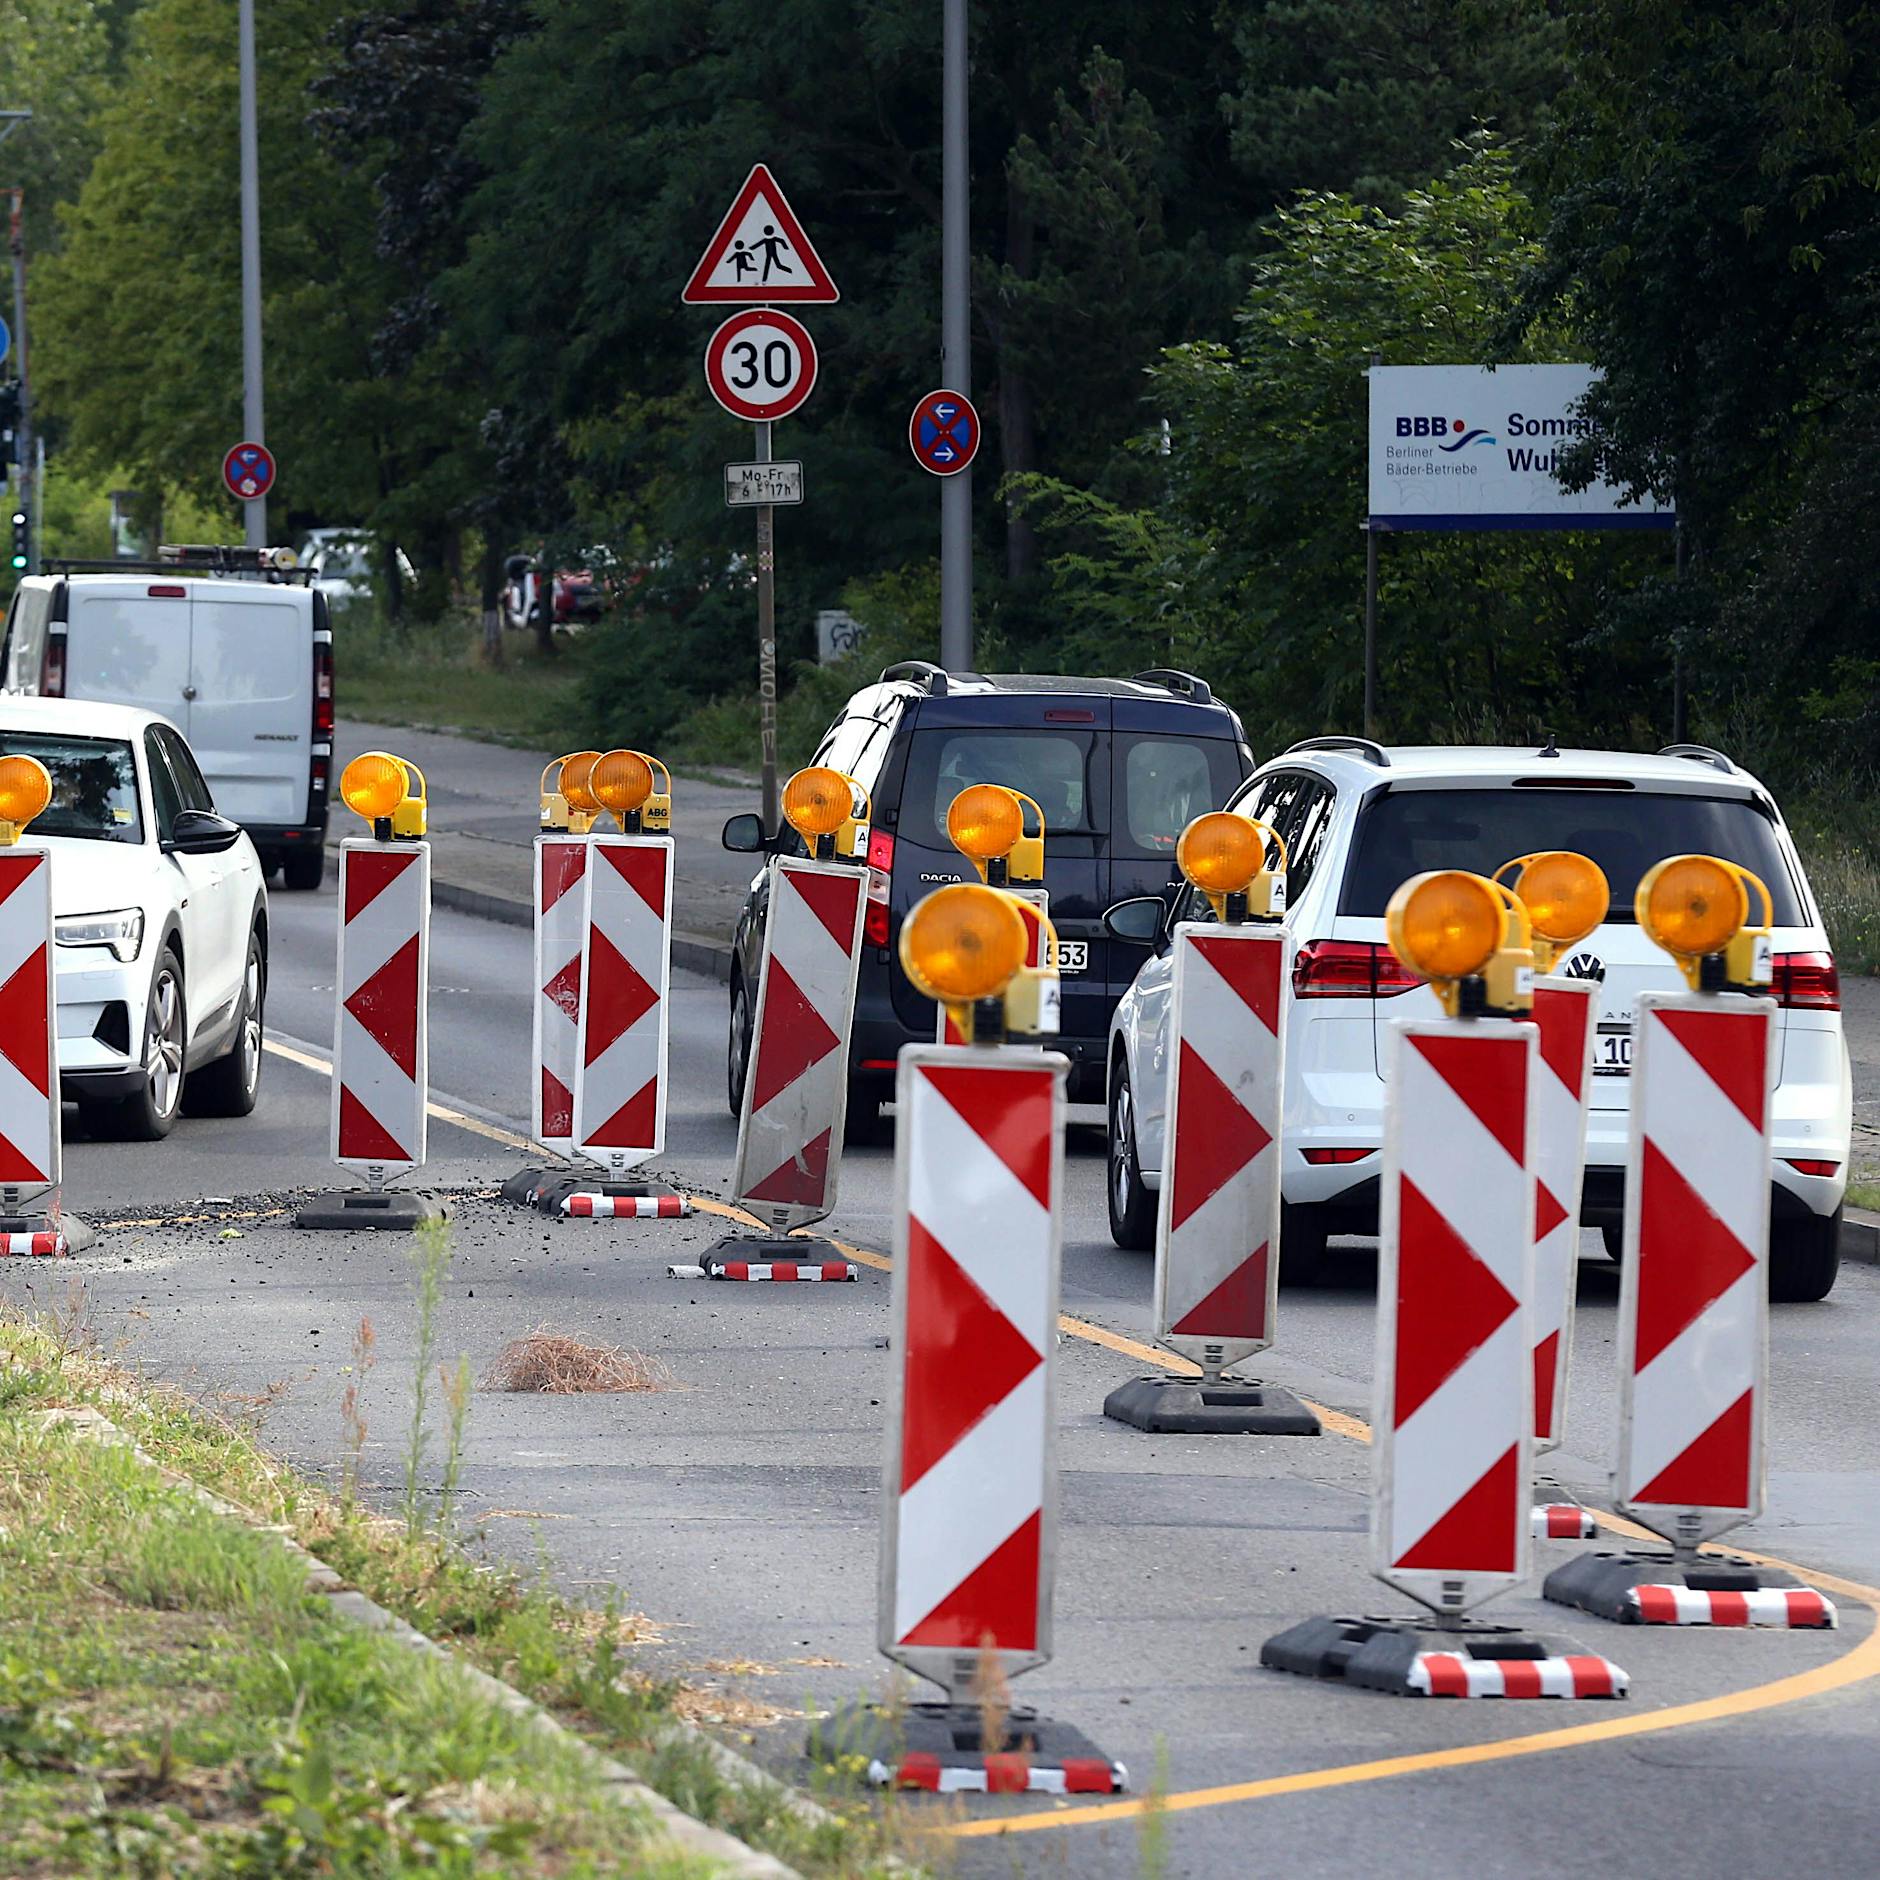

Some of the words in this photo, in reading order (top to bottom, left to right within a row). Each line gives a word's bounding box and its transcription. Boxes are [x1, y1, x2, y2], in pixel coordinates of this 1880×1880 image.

[731, 340, 792, 389] 30
[1396, 416, 1448, 437] BBB
[1386, 445, 1433, 458] Berliner
[742, 468, 783, 481] Mo-Fr
[1386, 462, 1478, 476] Bäder-Betriebe
[742, 485, 750, 497] 6
[647, 808, 668, 817] ABG
[920, 873, 962, 883] DACIA
